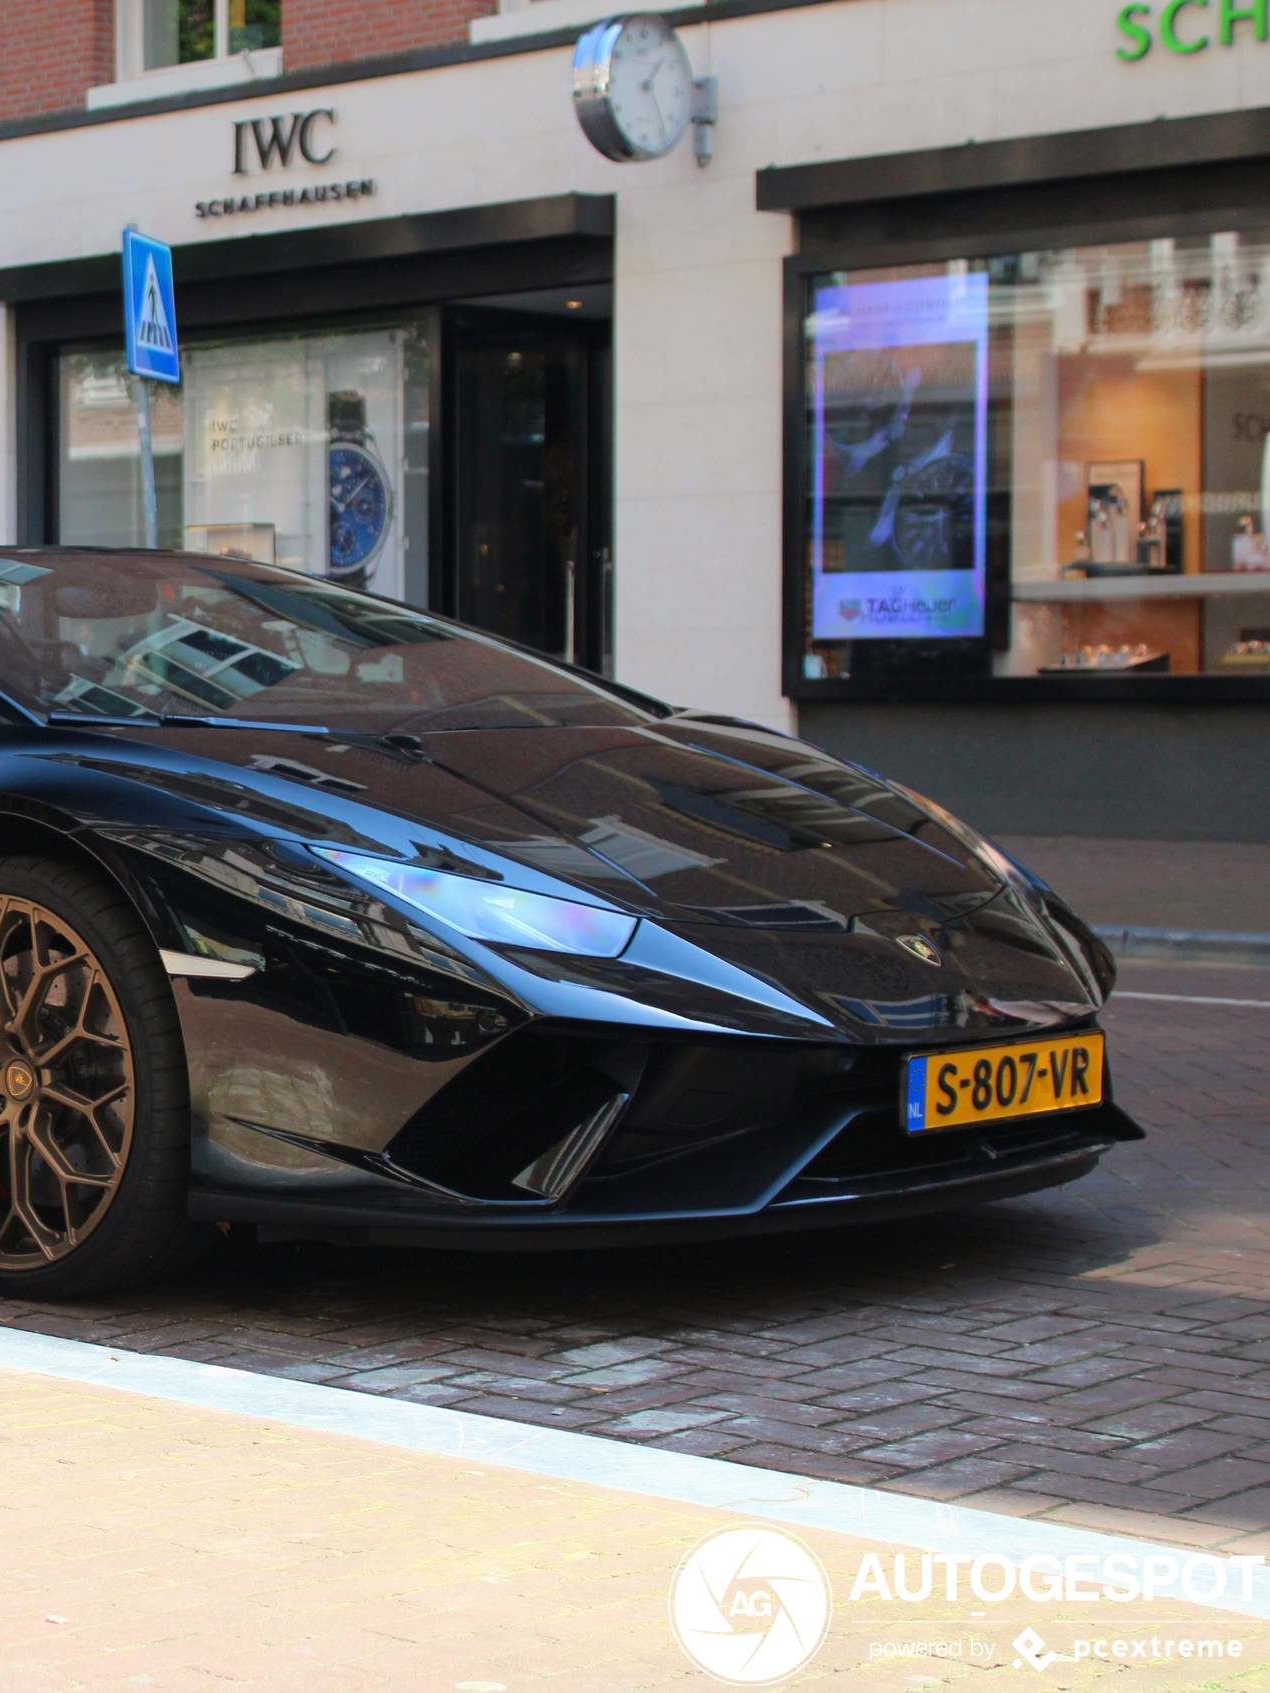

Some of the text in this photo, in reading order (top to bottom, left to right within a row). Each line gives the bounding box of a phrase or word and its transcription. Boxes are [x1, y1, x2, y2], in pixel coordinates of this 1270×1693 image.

[1115, 0, 1270, 61] SCH
[232, 107, 337, 175] IWC
[195, 178, 375, 218] SCHAFFHAUSEN
[908, 1102, 923, 1119] NL
[936, 1047, 1090, 1116] S-807-VR
